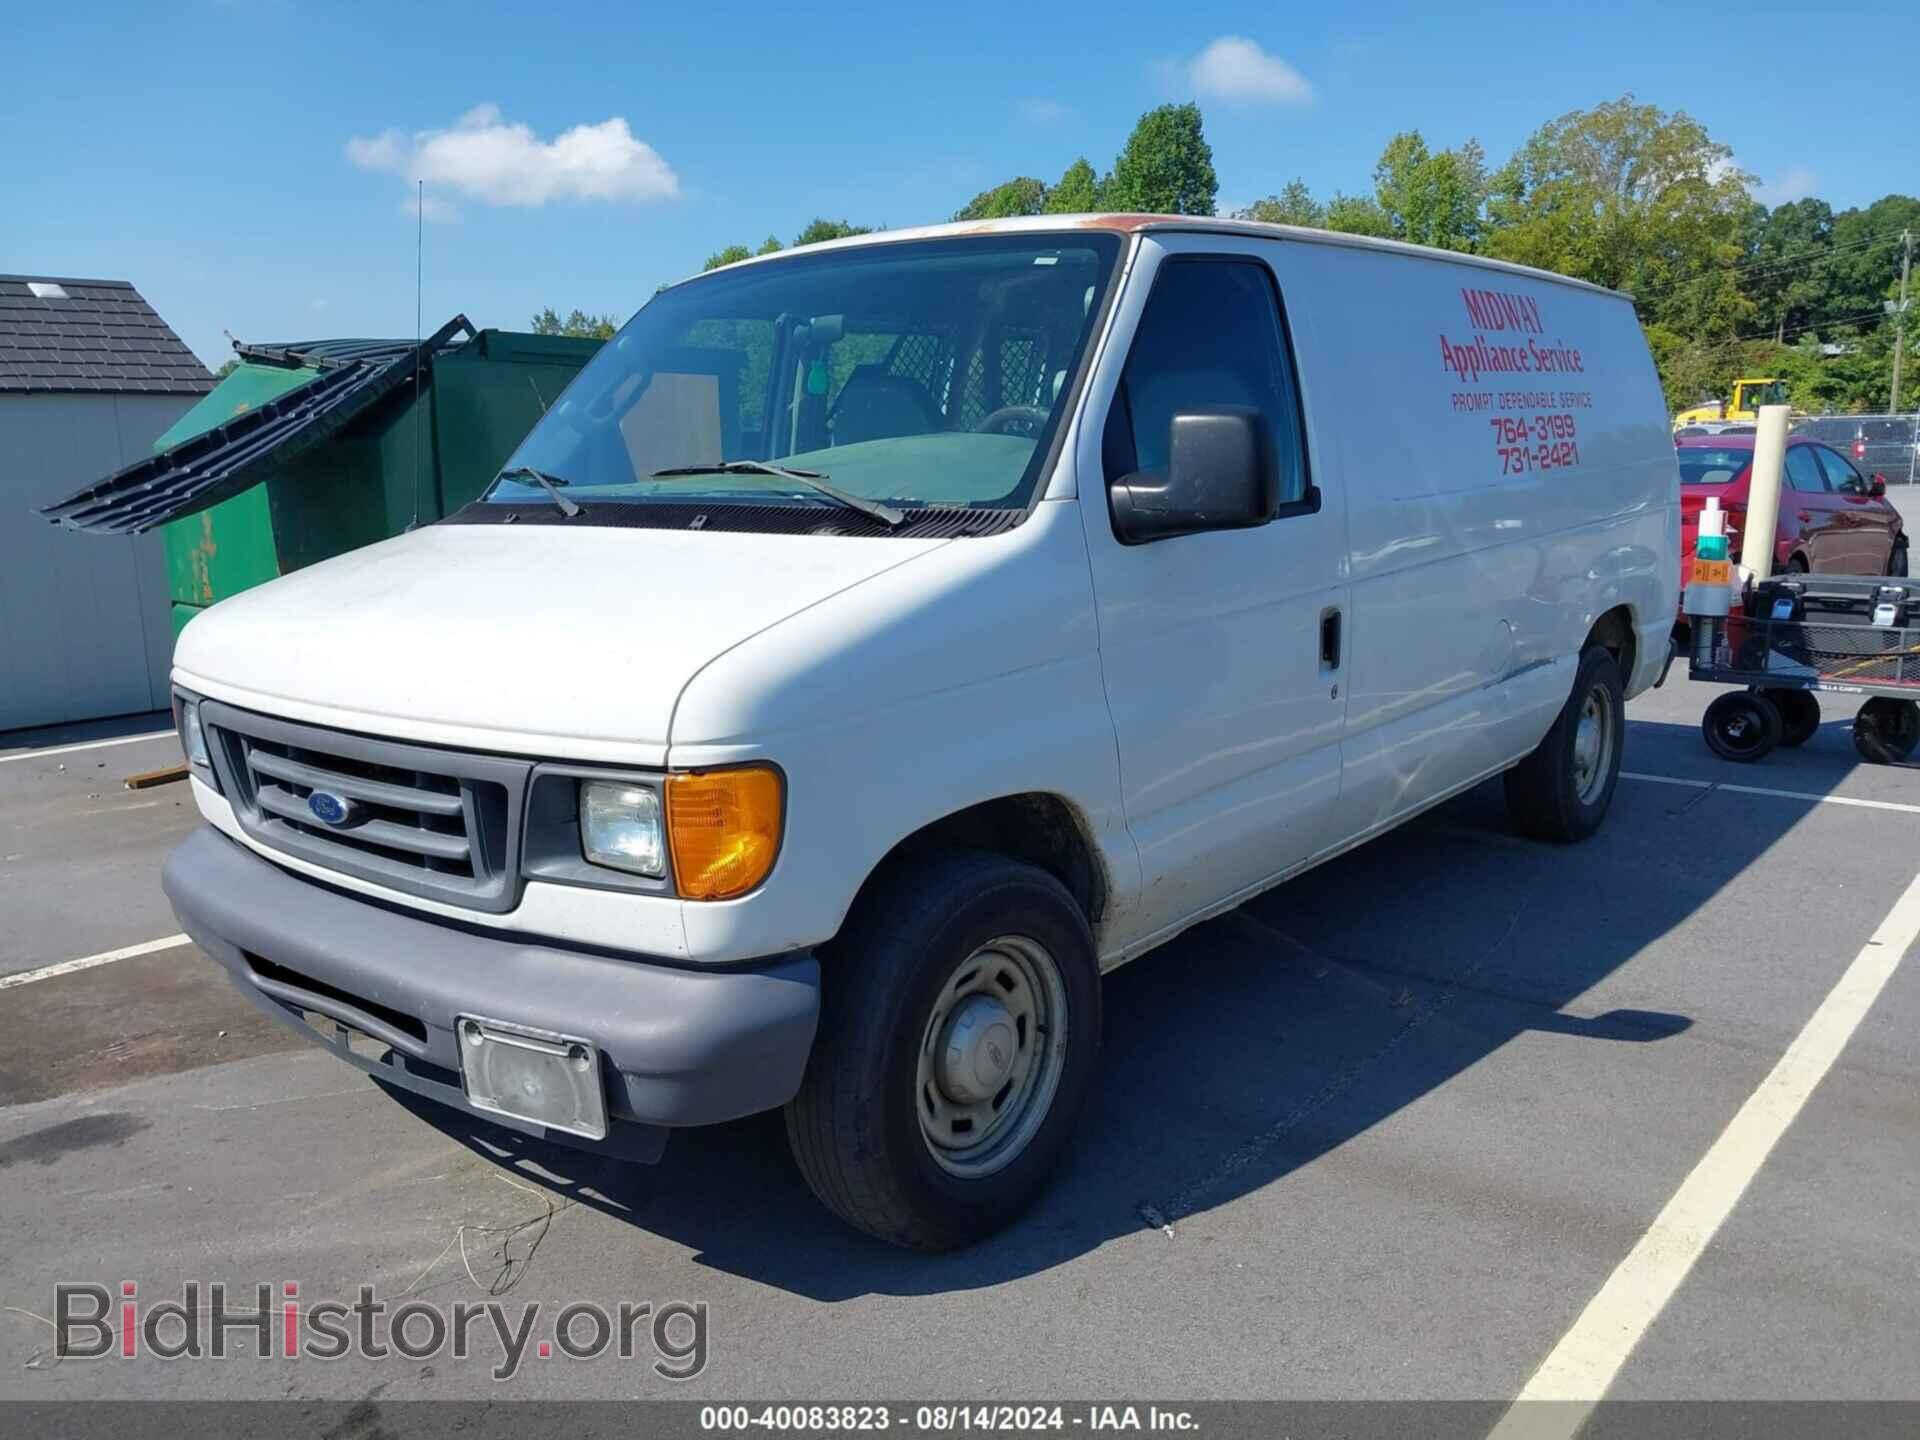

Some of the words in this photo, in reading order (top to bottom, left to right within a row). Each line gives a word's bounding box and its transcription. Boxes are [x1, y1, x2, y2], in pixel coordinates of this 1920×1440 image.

[1462, 287, 1543, 334] MIDWAY
[1440, 334, 1531, 383] Appliance
[1528, 338, 1584, 373] Service
[1452, 393, 1494, 412] PROMPT
[1499, 391, 1557, 410] DEPENDABLE
[1559, 391, 1592, 408] SERVICE
[1490, 414, 1576, 445] 764-3199
[1497, 442, 1580, 475] 731-2421
